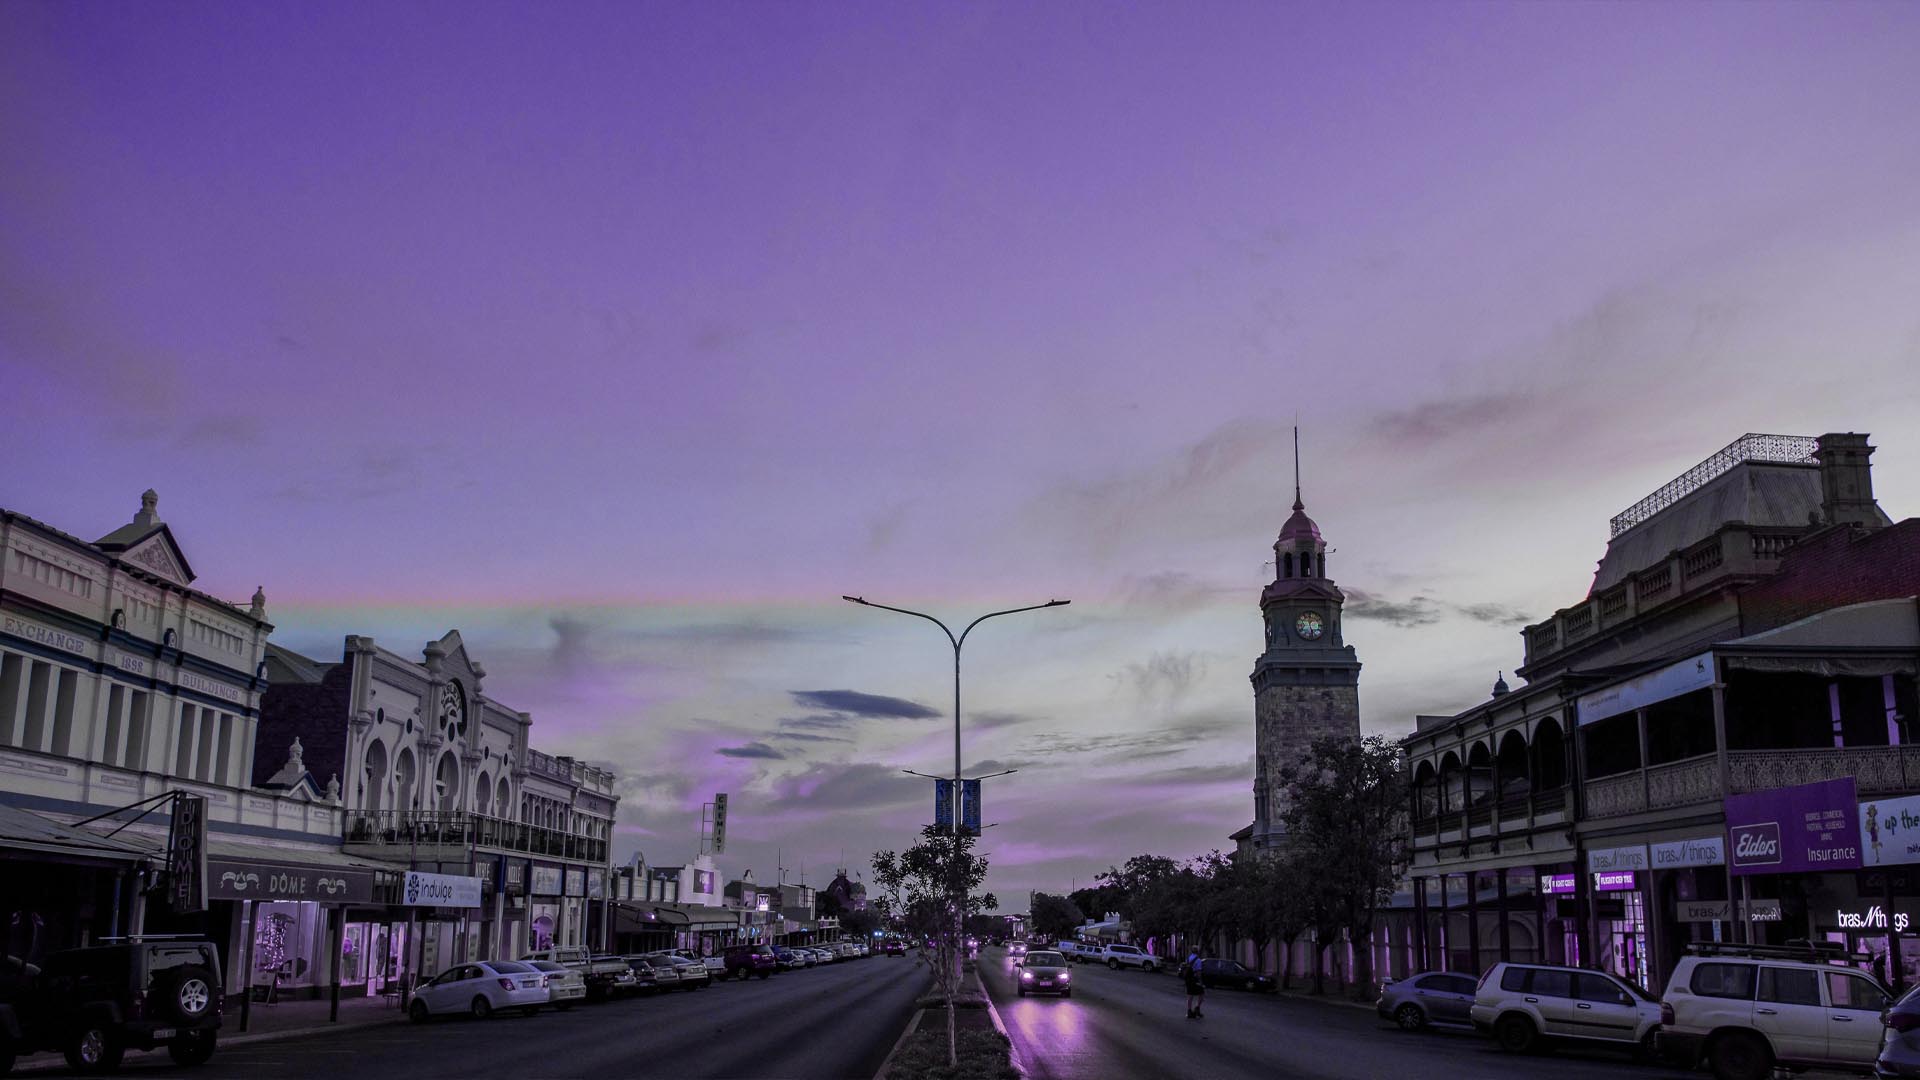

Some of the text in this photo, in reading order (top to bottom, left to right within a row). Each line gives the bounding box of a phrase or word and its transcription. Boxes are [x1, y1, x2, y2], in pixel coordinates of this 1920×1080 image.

[4, 617, 239, 701] EXCHANGE 1898 BUILDINGS
[716, 796, 724, 852] CHEMIST
[1884, 807, 1919, 836] up the
[1736, 833, 1777, 858] Elders
[1807, 847, 1856, 863] Insurance
[421, 878, 452, 903] indulge
[1688, 904, 1714, 918] bras
[1837, 909, 1861, 929] bras
[1875, 909, 1909, 932] thgs
